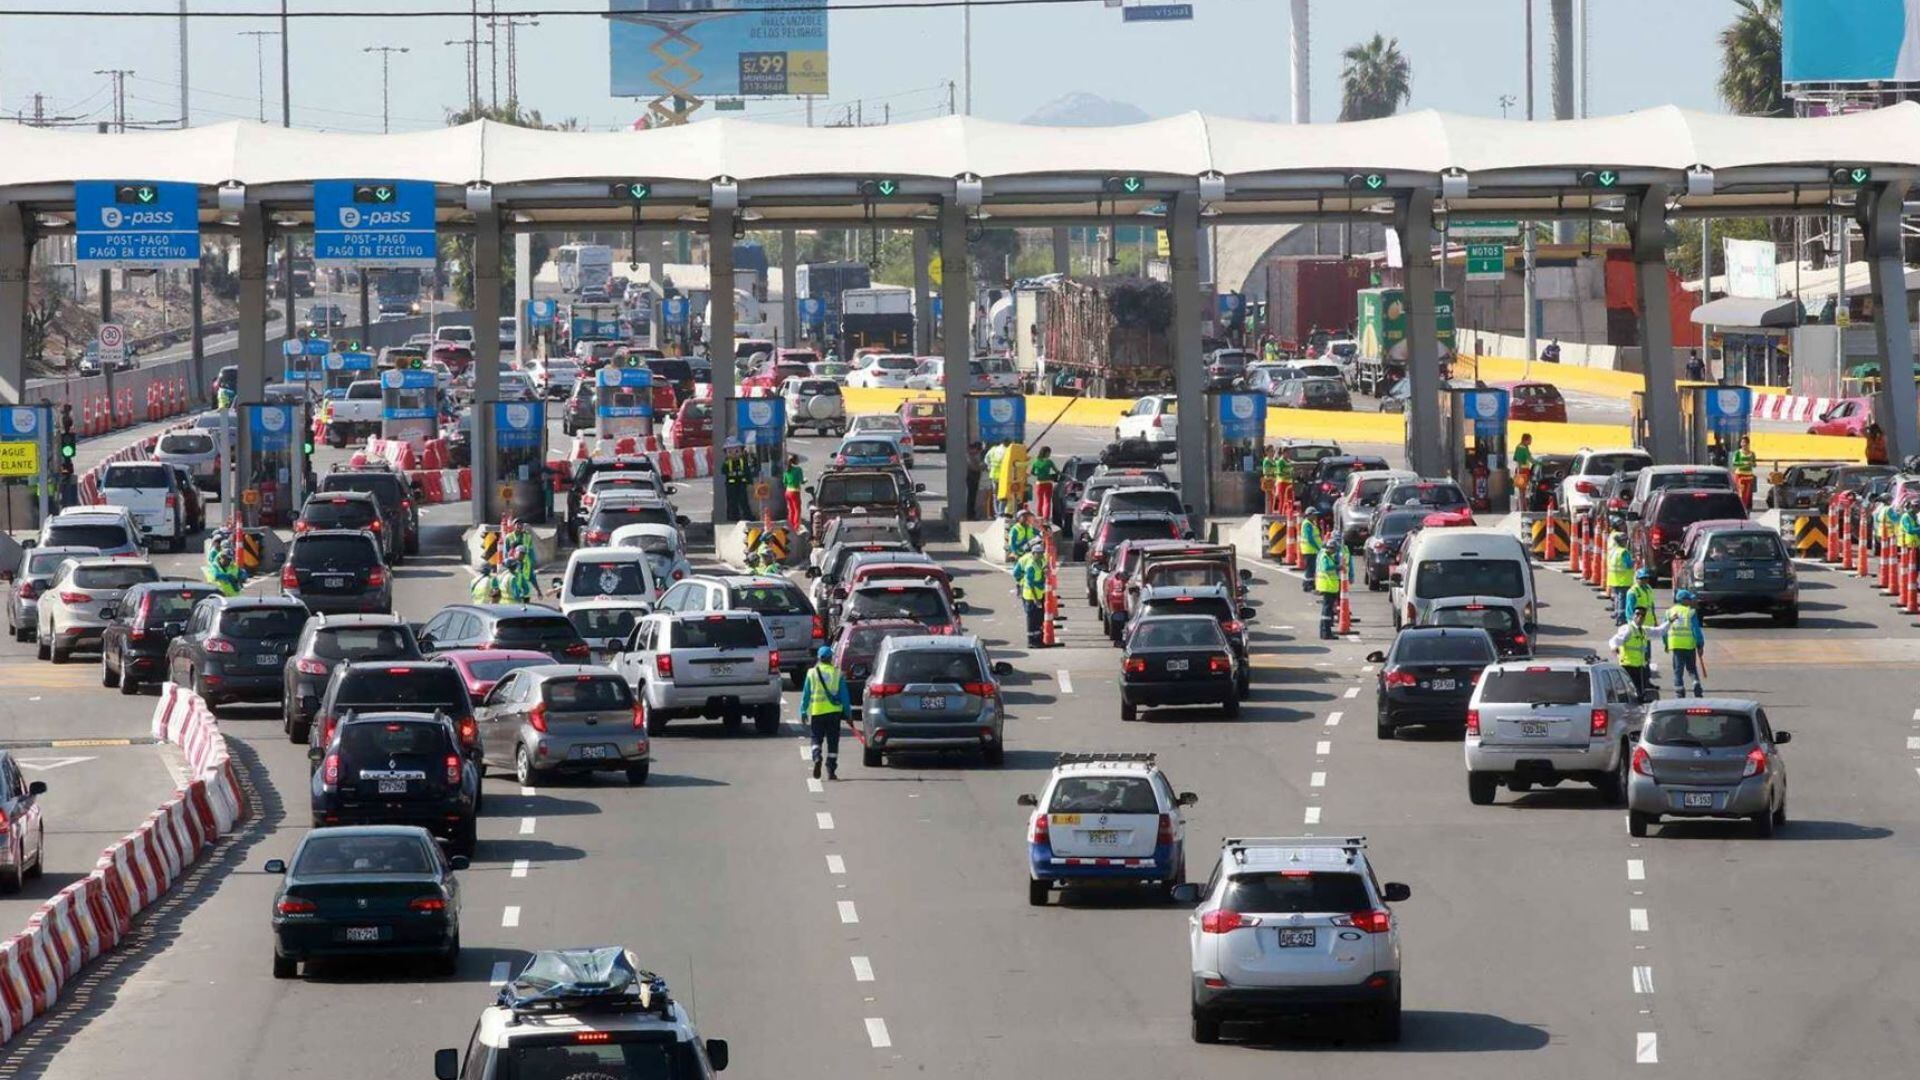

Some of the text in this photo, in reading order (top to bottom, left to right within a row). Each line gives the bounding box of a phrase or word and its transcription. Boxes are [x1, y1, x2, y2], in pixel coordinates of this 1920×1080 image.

[760, 55, 783, 72] 99
[102, 207, 174, 228] e-pass
[340, 207, 411, 228] e-pass
[106, 235, 169, 246] POST-PAGO
[344, 234, 406, 244] POST-PAGO
[89, 246, 187, 257] PAGO EN EFECTIVO
[327, 245, 424, 256] PAGO EN EFECTIVO
[1472, 247, 1499, 256] MOTOS
[105, 330, 117, 339] 30
